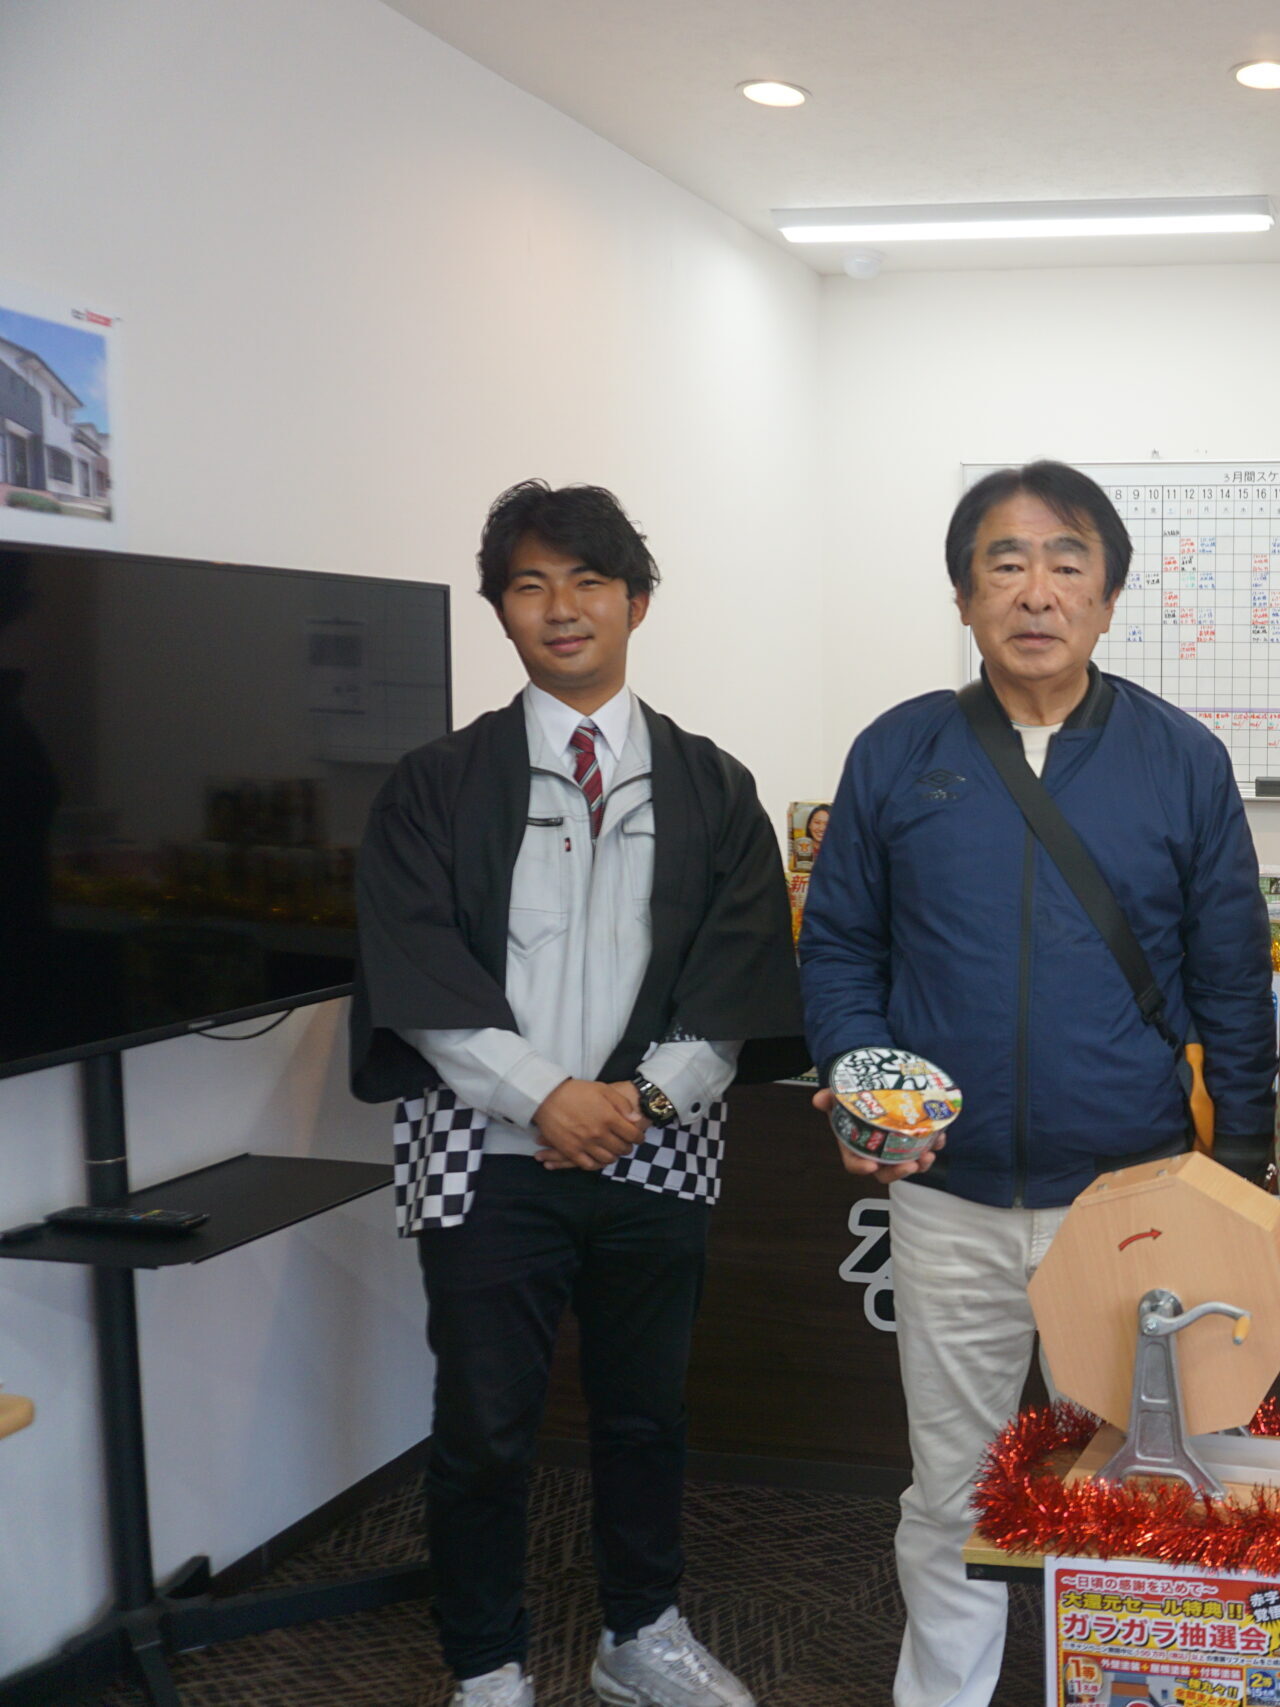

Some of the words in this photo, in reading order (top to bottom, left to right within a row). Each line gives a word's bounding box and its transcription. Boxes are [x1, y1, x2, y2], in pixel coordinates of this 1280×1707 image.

[1115, 489, 1122, 500] 8
[1133, 489, 1140, 500] 9
[1149, 489, 1159, 499] 10
[1167, 489, 1176, 499] 11
[1185, 489, 1195, 499] 12
[1203, 489, 1213, 499] 13
[1220, 488, 1230, 499] 14
[1239, 488, 1249, 499] 15
[1256, 488, 1267, 499] 16
[1063, 1613, 1269, 1653] ガラガラ抽選会
